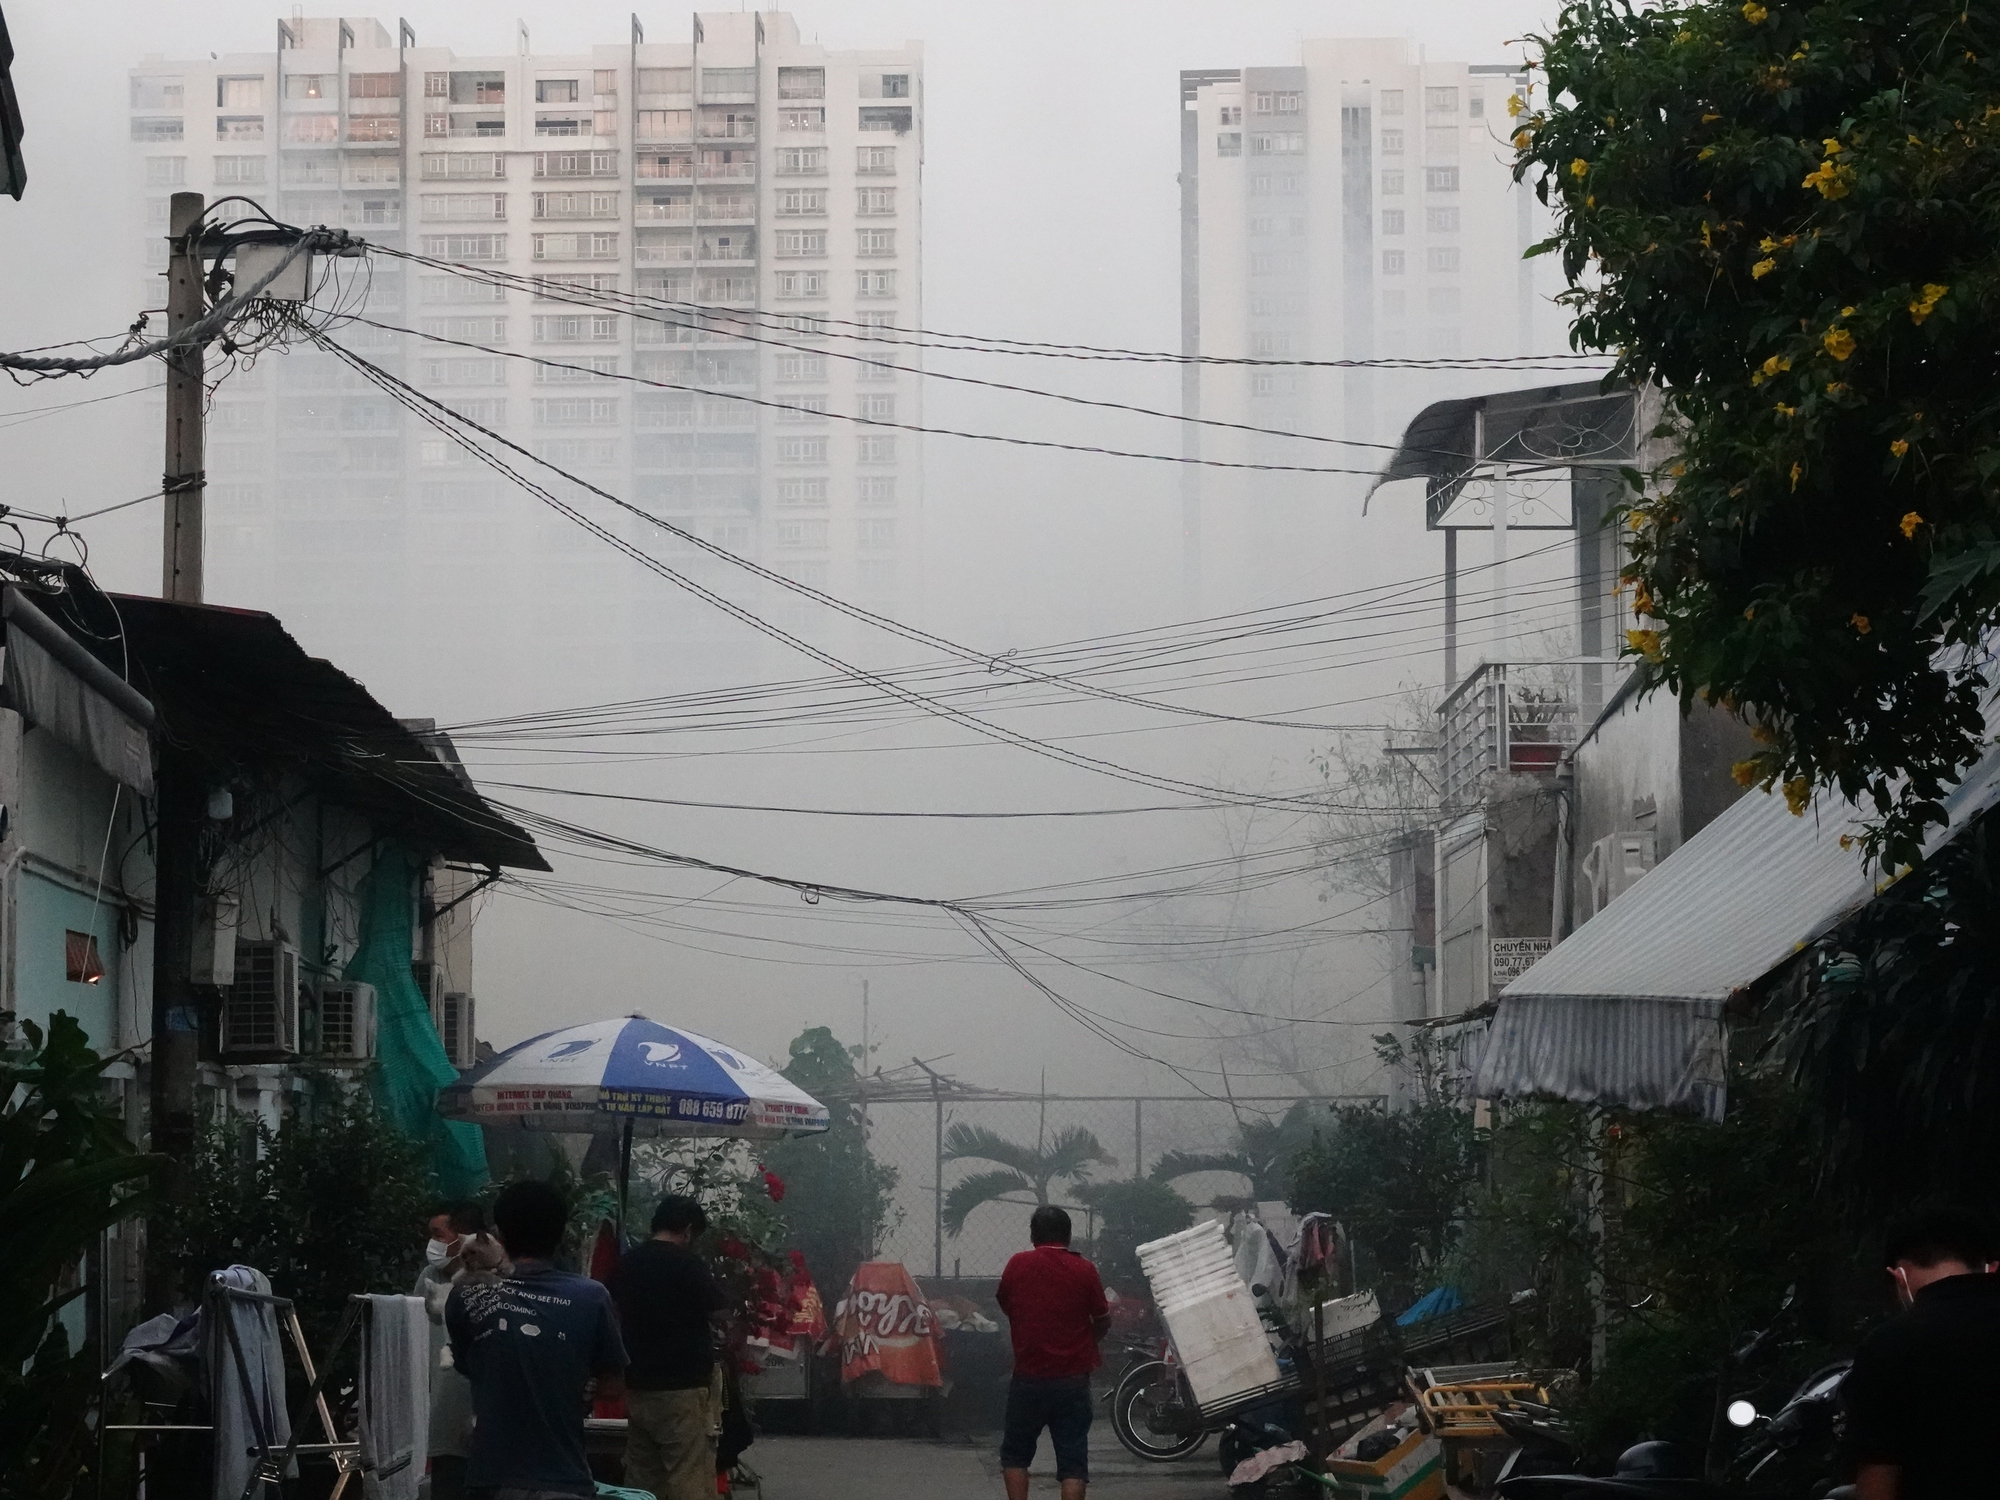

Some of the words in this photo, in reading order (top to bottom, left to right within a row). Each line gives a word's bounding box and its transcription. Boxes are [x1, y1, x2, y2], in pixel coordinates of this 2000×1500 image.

[1493, 939, 1531, 952] CHUYỂN
[643, 1060, 689, 1070] VNPT
[678, 1098, 700, 1115] 088
[702, 1101, 723, 1118] 659
[517, 1291, 536, 1300] AND
[537, 1295, 552, 1303] SEE
[553, 1297, 572, 1306] THAT
